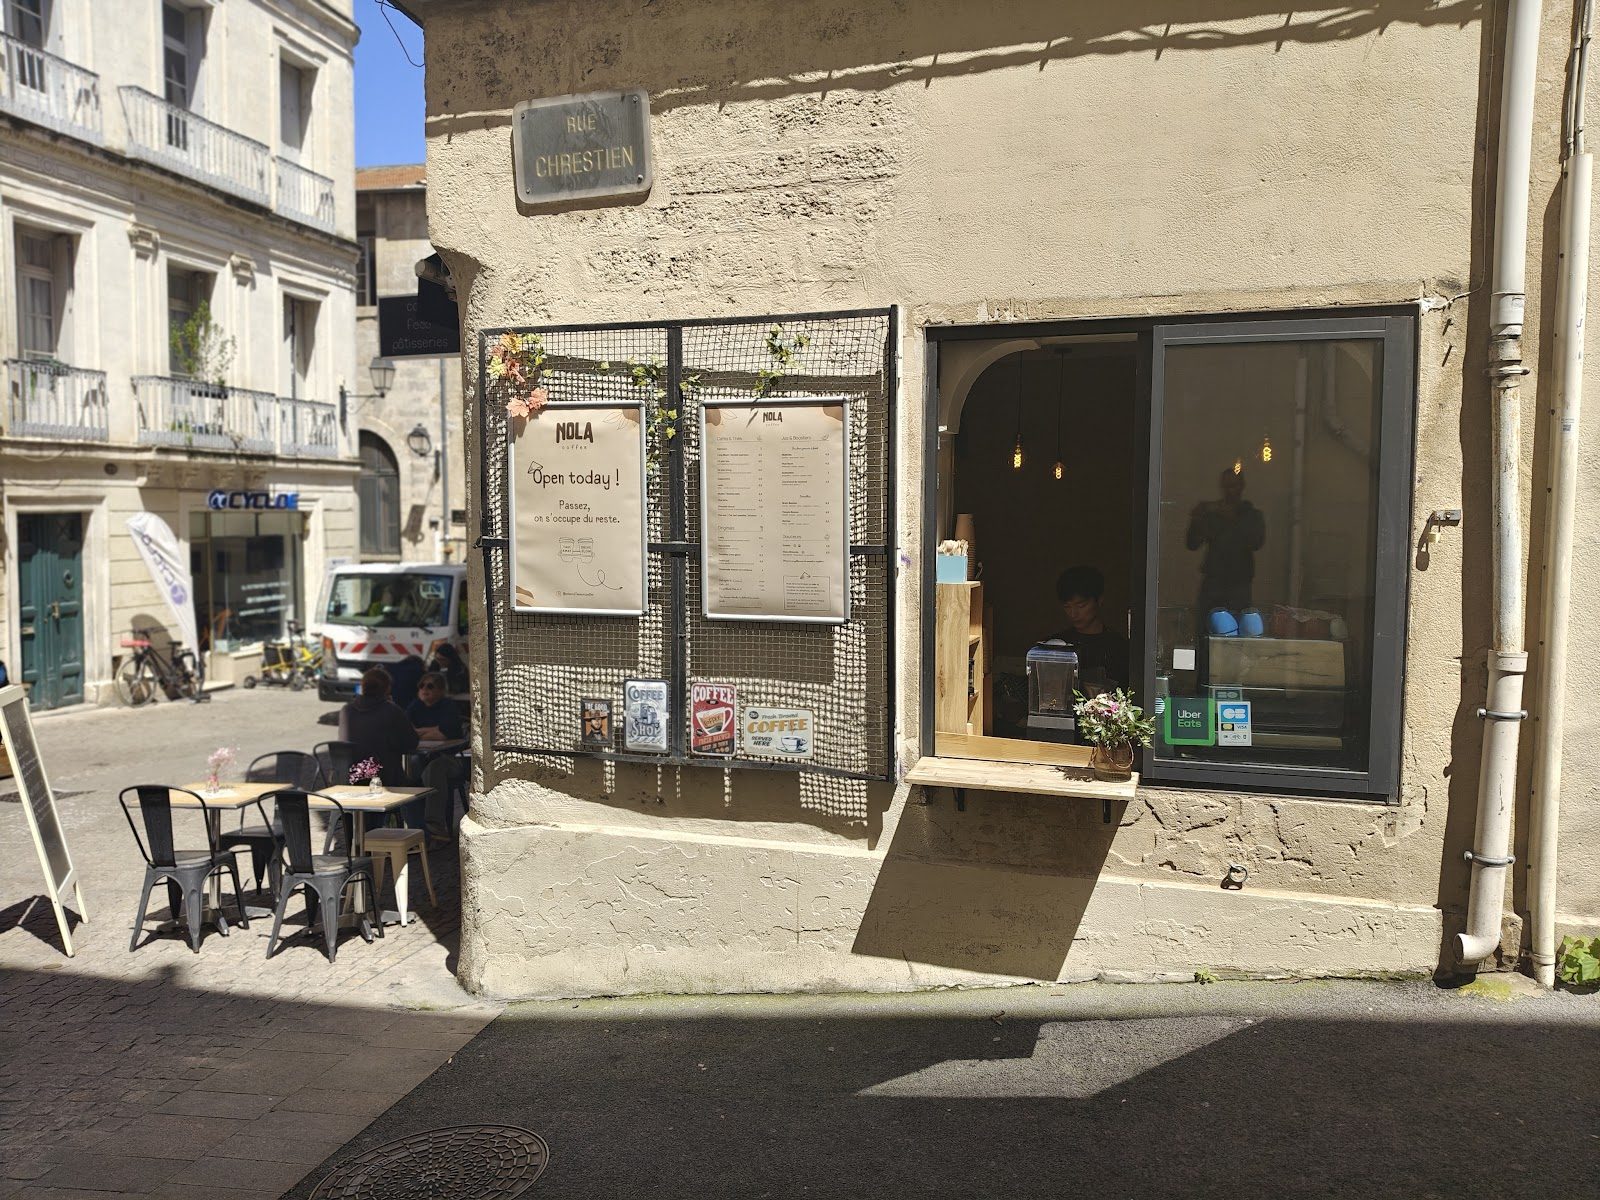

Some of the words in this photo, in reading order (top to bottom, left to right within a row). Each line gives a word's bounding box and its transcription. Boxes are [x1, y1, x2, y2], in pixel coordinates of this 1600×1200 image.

[567, 114, 596, 133] RUE
[535, 145, 634, 178] CHRESTIEN
[762, 411, 783, 423] NOLA
[555, 421, 594, 443] NOLA
[532, 468, 565, 489] Open
[568, 469, 611, 490] today
[559, 499, 591, 512] Passez,
[545, 513, 581, 525] s'occupe
[583, 514, 594, 522] du
[595, 515, 621, 524] reste.
[628, 686, 665, 702] COFFEE
[693, 686, 734, 705] COFFEE
[1177, 710, 1202, 719] Uber
[631, 722, 661, 738] SHOP
[747, 718, 808, 734] COFFEE
[1177, 719, 1202, 728] Eats
